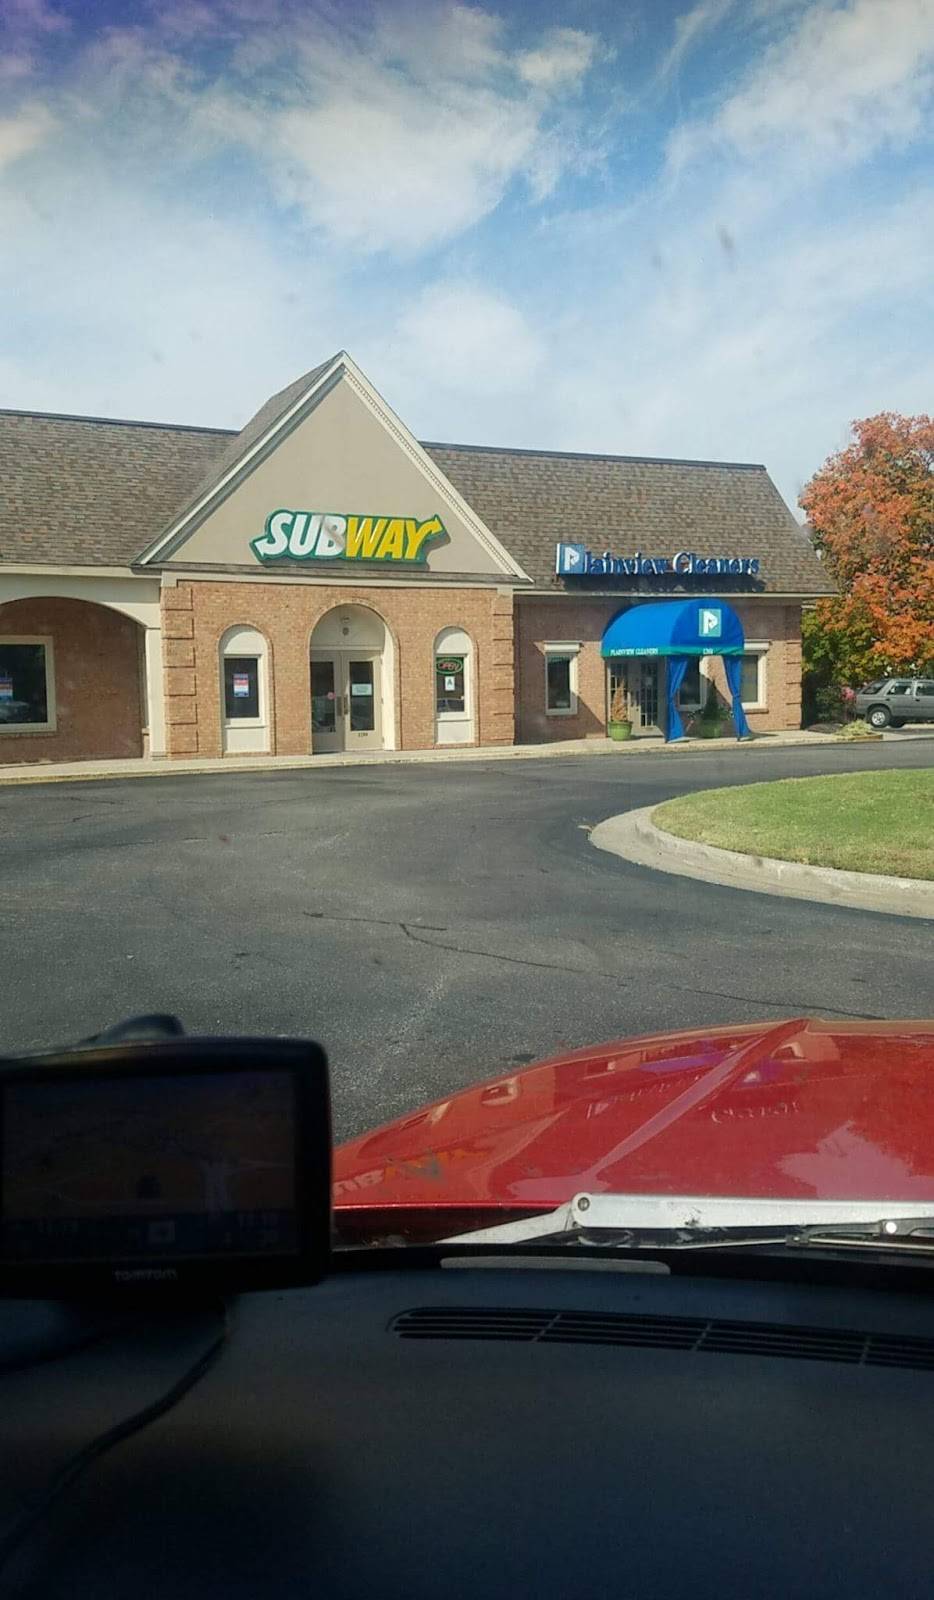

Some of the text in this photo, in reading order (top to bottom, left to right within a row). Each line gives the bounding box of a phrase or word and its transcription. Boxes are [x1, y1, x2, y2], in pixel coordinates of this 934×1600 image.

[254, 511, 443, 560] SUBWAY
[562, 547, 760, 575] Plainview Cleaners
[703, 611, 718, 635] P
